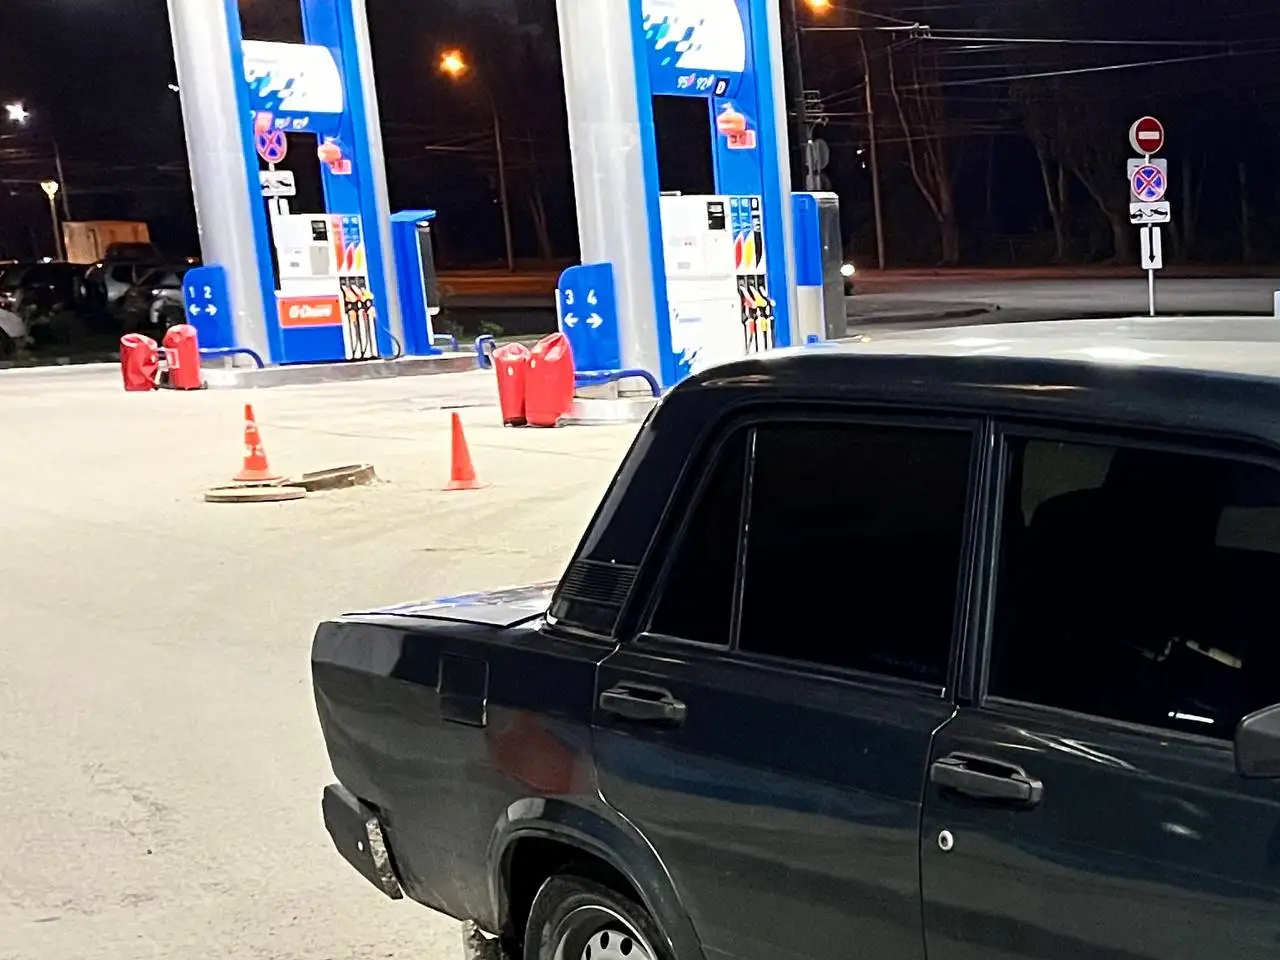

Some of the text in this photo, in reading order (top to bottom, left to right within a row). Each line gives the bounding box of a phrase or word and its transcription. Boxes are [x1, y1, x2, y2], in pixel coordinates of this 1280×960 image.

[188, 286, 212, 299] 1 2
[565, 289, 598, 305] 3 4
